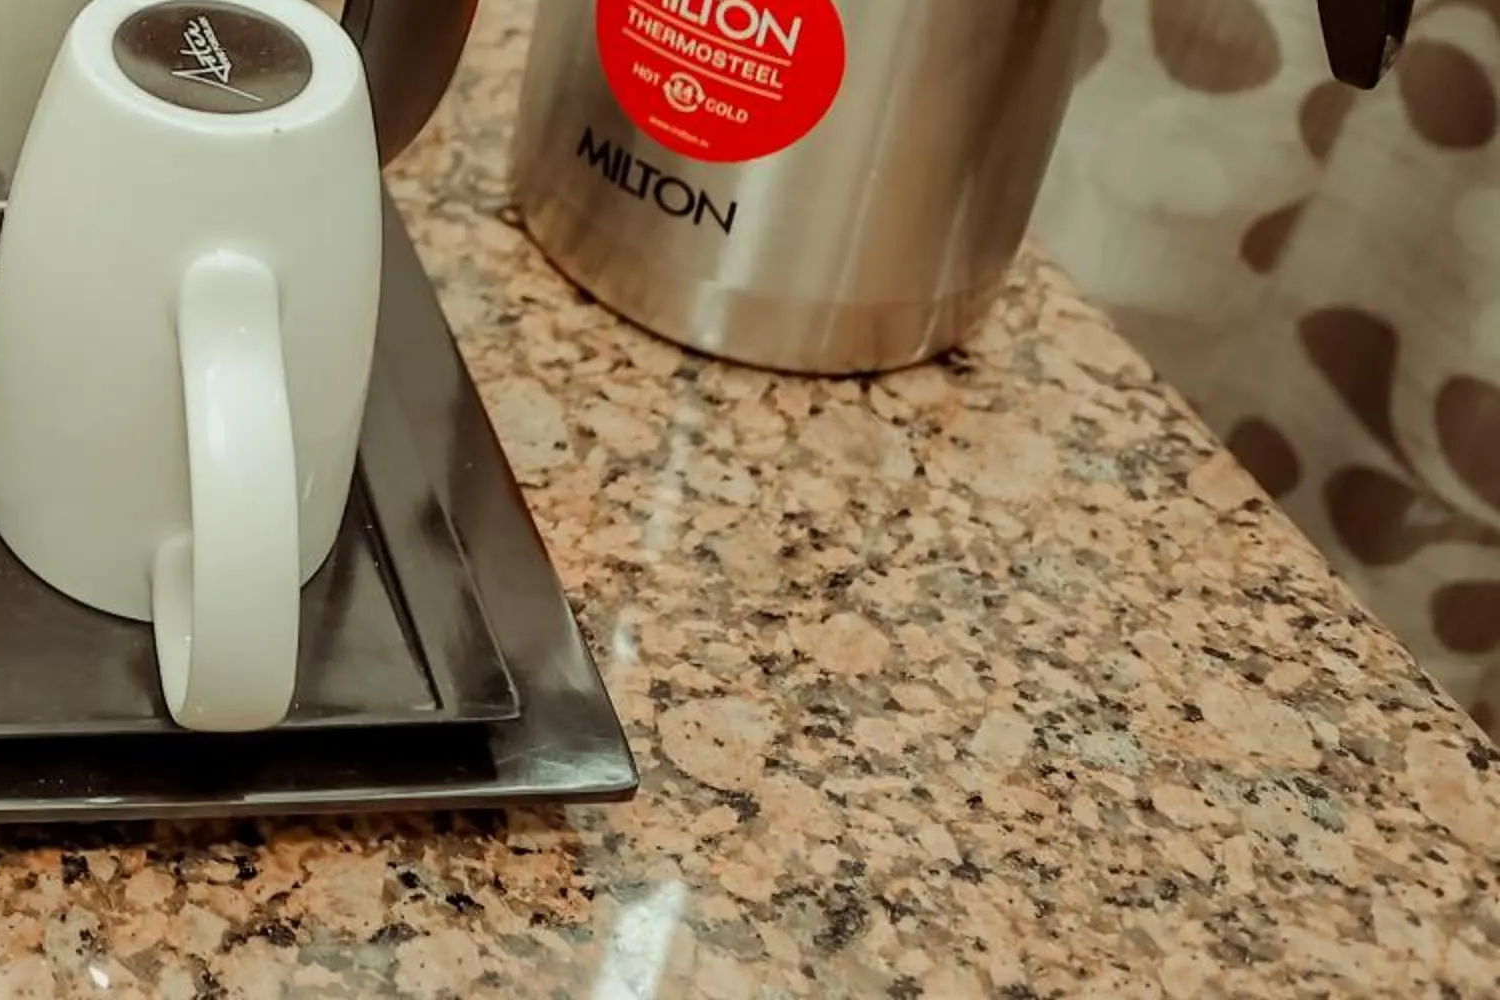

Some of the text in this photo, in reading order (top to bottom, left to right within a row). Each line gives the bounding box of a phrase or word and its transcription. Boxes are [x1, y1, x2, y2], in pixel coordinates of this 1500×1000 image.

[627, 6, 784, 89] THERMOSTEEL
[632, 61, 661, 87] HOT
[576, 126, 737, 236] MILTON
